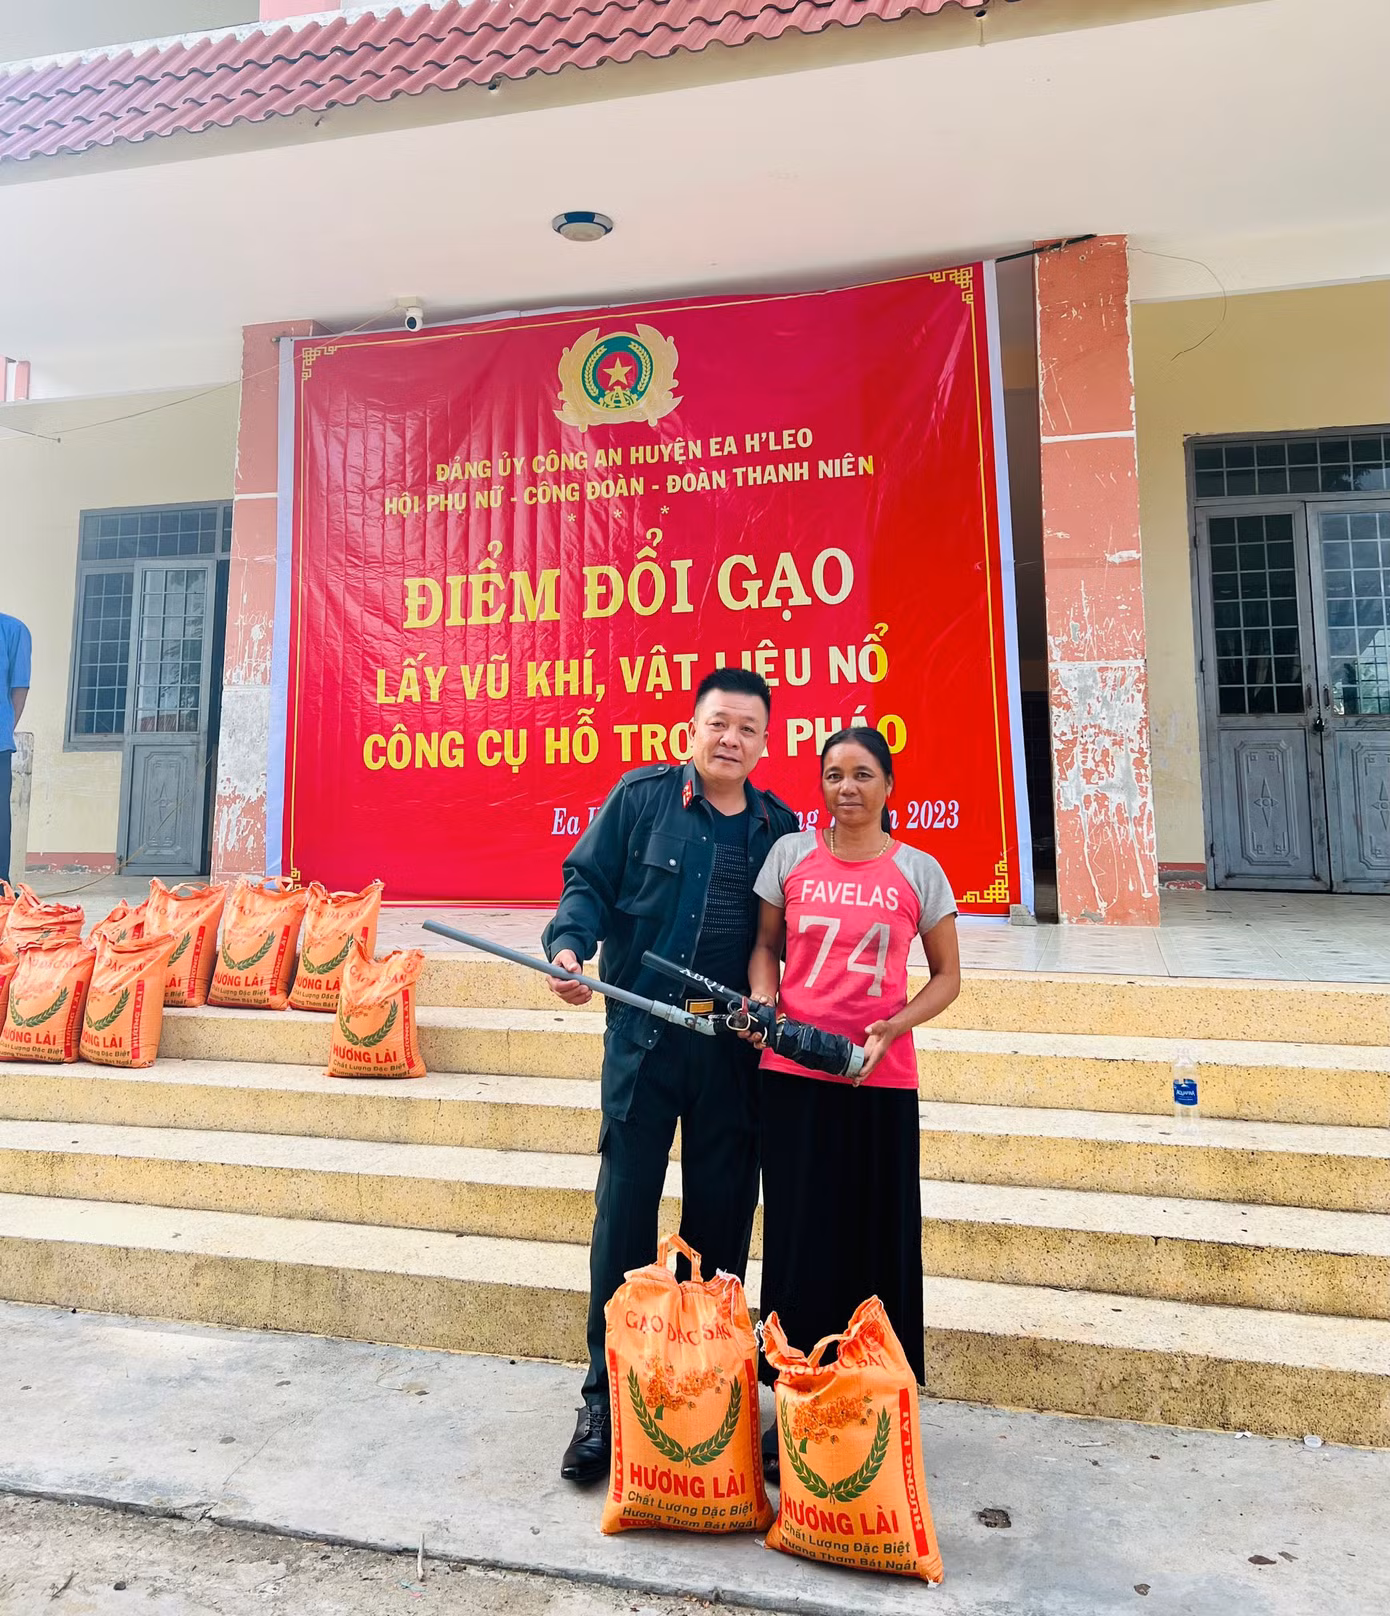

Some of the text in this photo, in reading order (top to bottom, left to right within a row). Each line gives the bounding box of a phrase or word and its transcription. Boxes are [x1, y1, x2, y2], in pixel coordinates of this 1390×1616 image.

[436, 455, 491, 481] ĐẢNG
[499, 451, 525, 477] ỦY
[532, 449, 588, 474] CÔNG
[594, 447, 622, 468] AN
[630, 437, 702, 464] HUYỆN
[710, 436, 738, 457] EA
[384, 491, 419, 518] HỘI
[425, 495, 467, 516] PHỤ
[475, 486, 504, 508] NỮ
[524, 481, 580, 505] CÔNG
[586, 474, 644, 499] ĐOÀN
[666, 468, 726, 494] ĐOÀN
[732, 461, 809, 487] THANH
[818, 452, 874, 479] NIÊN
[403, 527, 855, 629] ĐIỂM ĐỔI GẠO
[376, 652, 448, 704] LẤY
[460, 653, 510, 701] VŨ
[527, 648, 606, 703] KHÍ,
[619, 645, 698, 700] VẬT
[828, 622, 889, 683] NỔ
[363, 723, 465, 771] CÔNG
[477, 728, 528, 774] CỤ
[545, 707, 599, 765] HỖ
[551, 807, 580, 836] Ea
[906, 799, 960, 830] 2023
[801, 879, 899, 911] FAVELAS
[798, 915, 891, 997] 74
[164, 974, 181, 988] ÀI
[245, 973, 264, 987] LÀI
[326, 977, 340, 991] LÀ
[35, 1030, 56, 1045] LÀI
[103, 1033, 122, 1048] LÀI
[333, 1043, 397, 1064] HƯƠNG LÀI
[630, 1462, 746, 1499] HƯƠNG LÀI
[623, 1506, 662, 1521] Hương
[628, 1491, 753, 1518] Chất Lượng Đặc Biệt
[784, 1491, 899, 1535] HƯƠNG LÀI
[784, 1519, 910, 1557] Chất Lượng Đặc Biệt
[860, 1558, 881, 1568] Bát
[885, 1560, 917, 1571] Ngát
